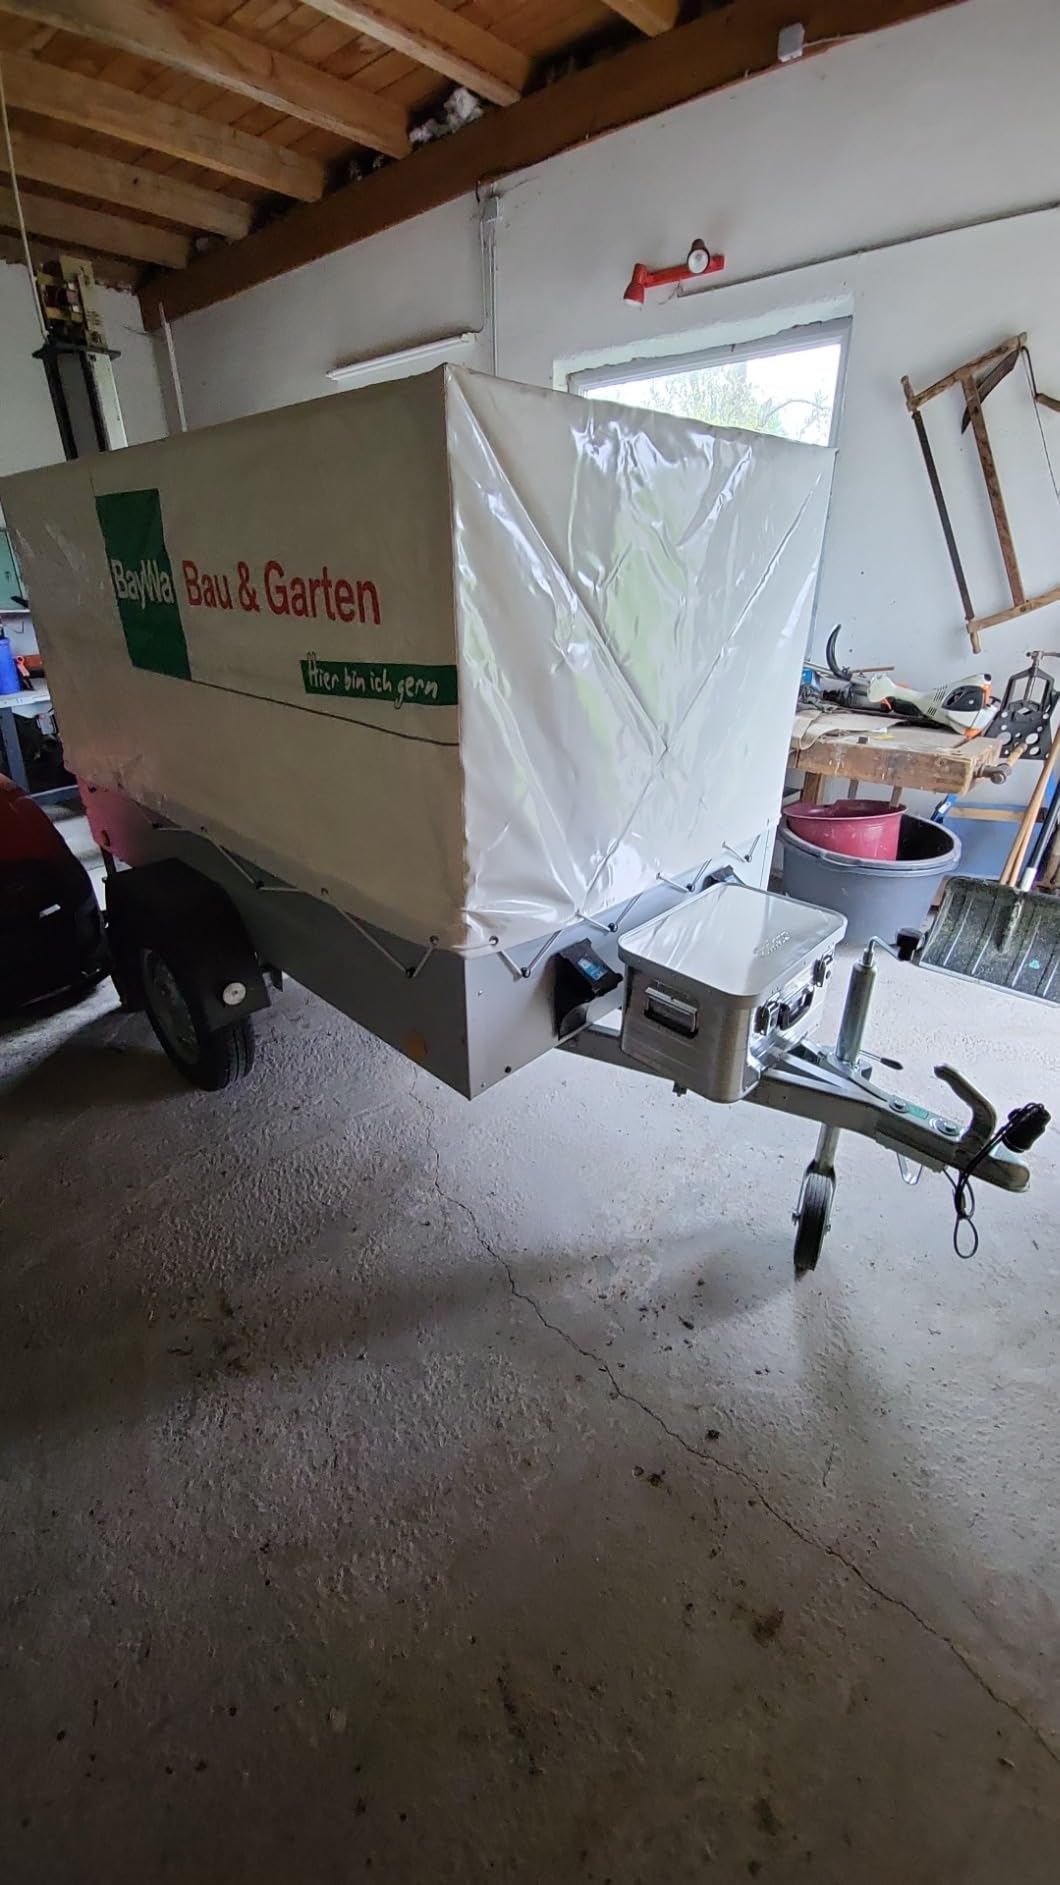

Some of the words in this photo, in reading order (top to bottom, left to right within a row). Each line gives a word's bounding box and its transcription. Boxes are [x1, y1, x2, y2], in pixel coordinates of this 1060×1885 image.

[111, 559, 175, 610] BayWa
[182, 560, 233, 609] Bau
[237, 560, 260, 613] &
[264, 560, 381, 625] Garten
[306, 651, 339, 690] Hier
[344, 666, 366, 692] bin
[370, 668, 392, 693] ich
[394, 675, 439, 710] gern
